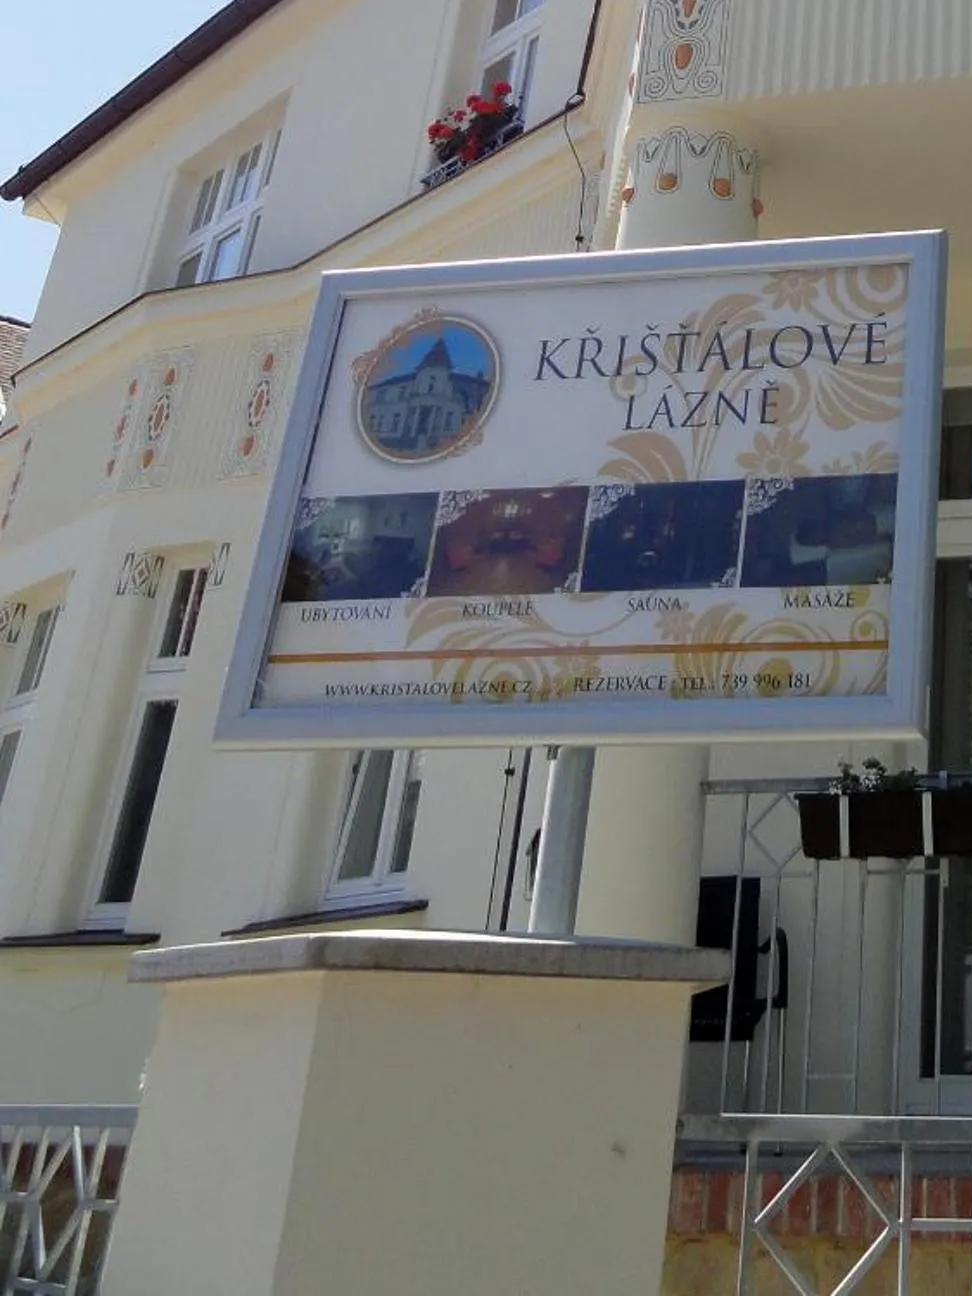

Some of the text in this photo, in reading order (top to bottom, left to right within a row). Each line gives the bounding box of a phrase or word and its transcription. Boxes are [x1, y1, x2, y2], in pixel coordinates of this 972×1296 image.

[533, 313, 888, 380] KŘIŠŤÁLOVÉ
[622, 379, 780, 431] LÁZNĚ
[463, 599, 534, 616] KOUPELE
[628, 596, 682, 612] SAUNA
[573, 675, 668, 692] REZERVACE
[722, 672, 748, 690] 739
[752, 672, 781, 690] 996
[787, 672, 811, 689] 181
